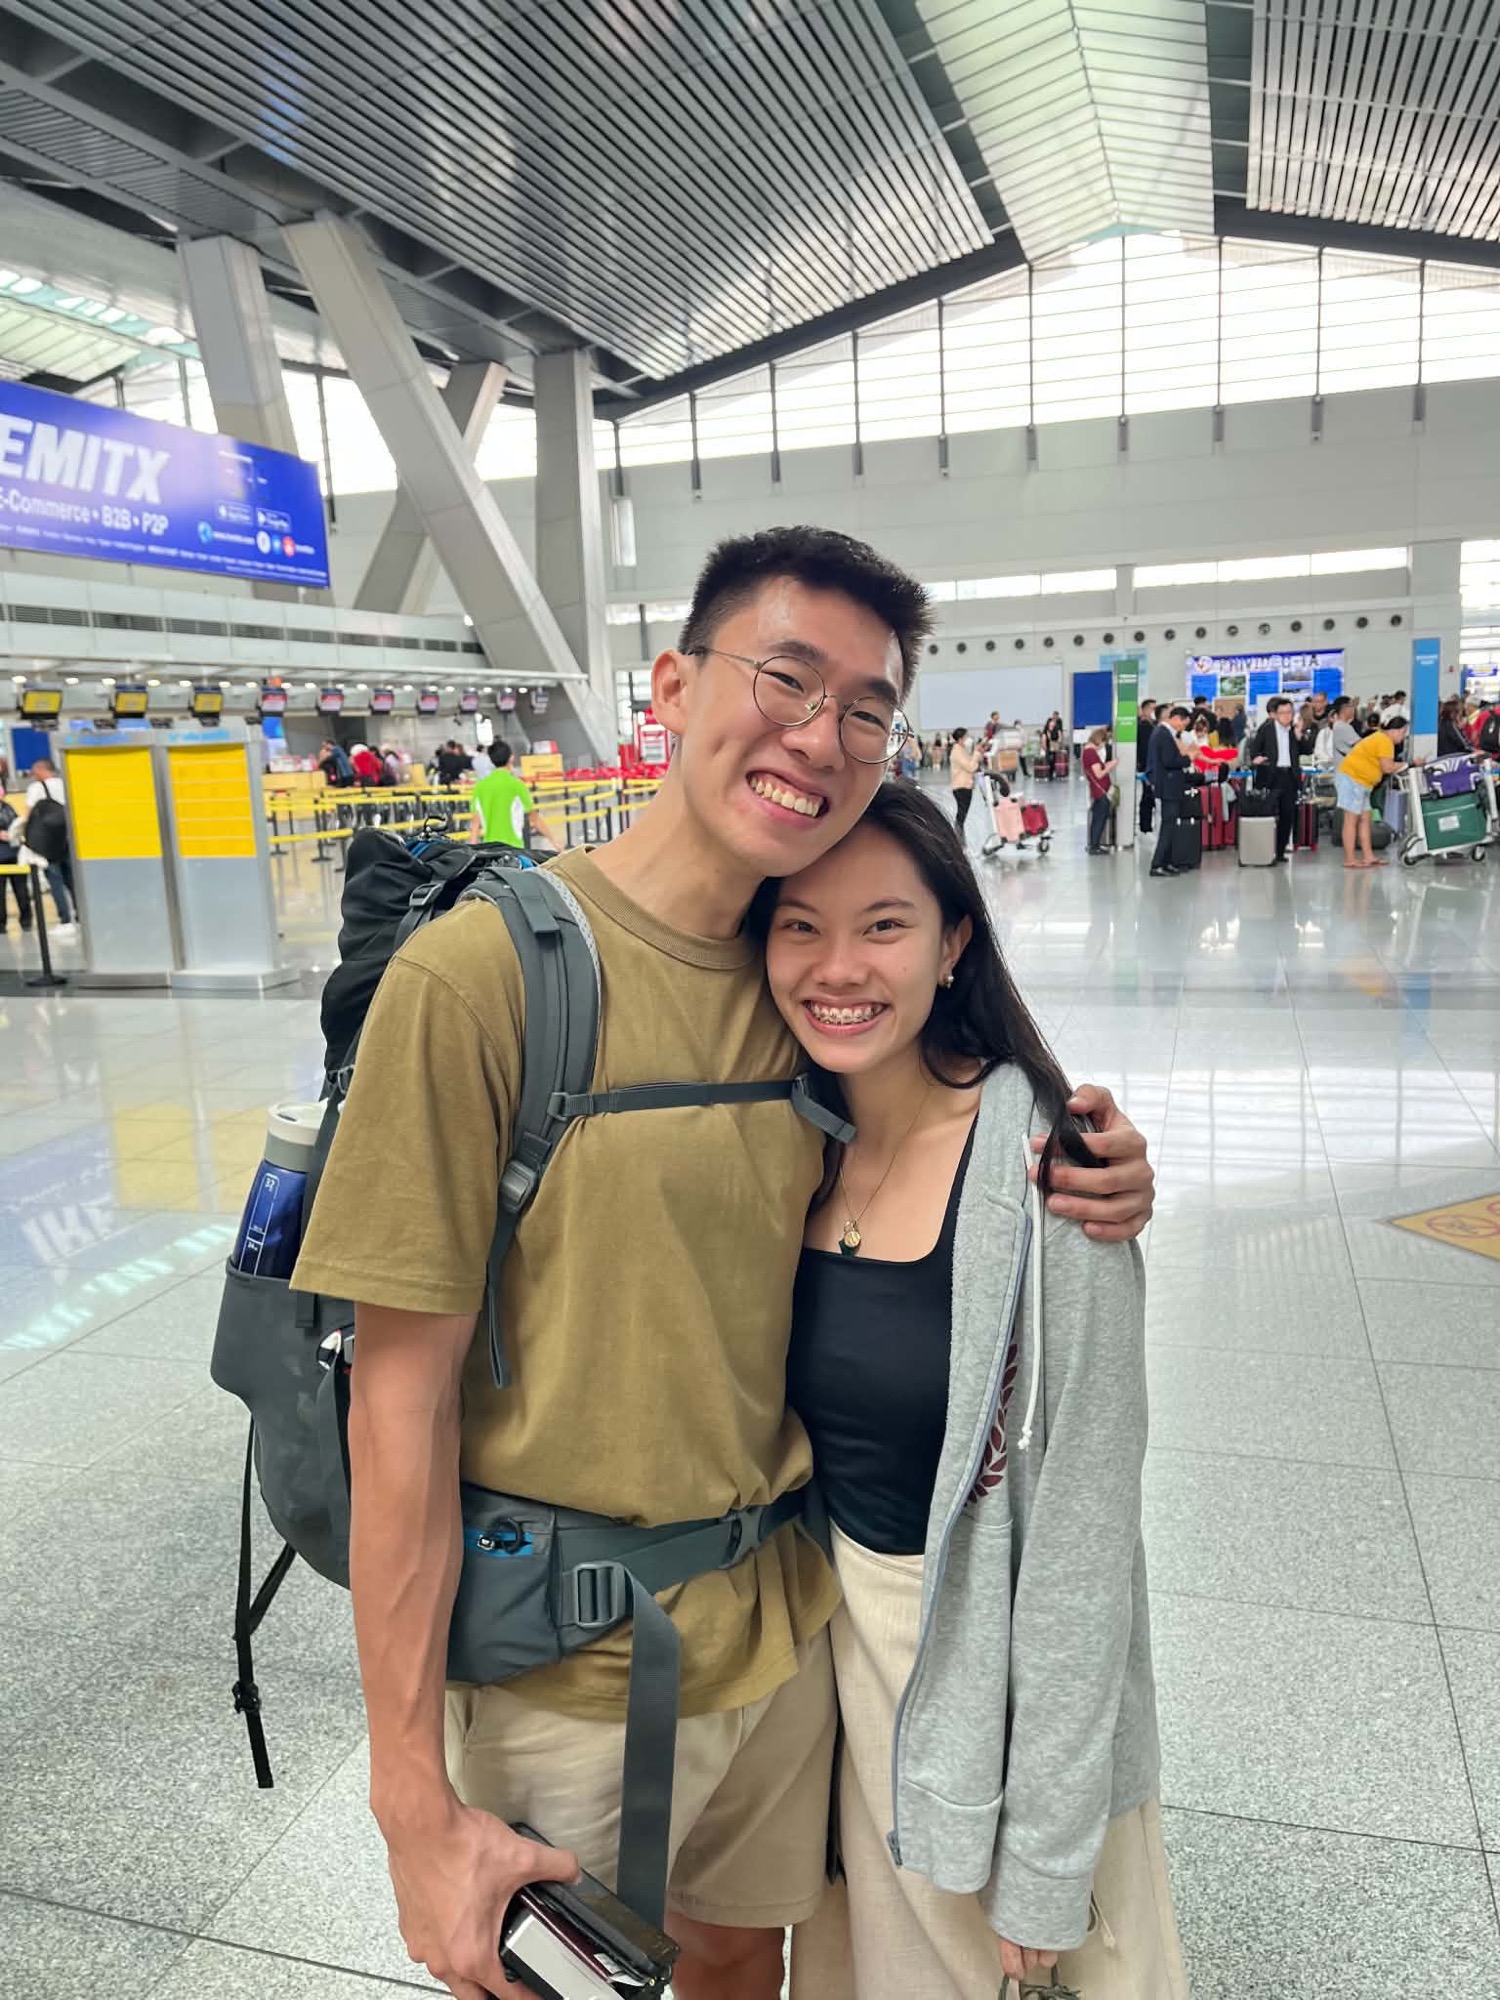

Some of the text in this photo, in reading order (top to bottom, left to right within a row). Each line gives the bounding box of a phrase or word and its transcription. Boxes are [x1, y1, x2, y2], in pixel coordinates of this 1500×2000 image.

[0, 413, 171, 504] EMITX
[101, 505, 132, 530] B2B
[142, 511, 169, 536] P2P
